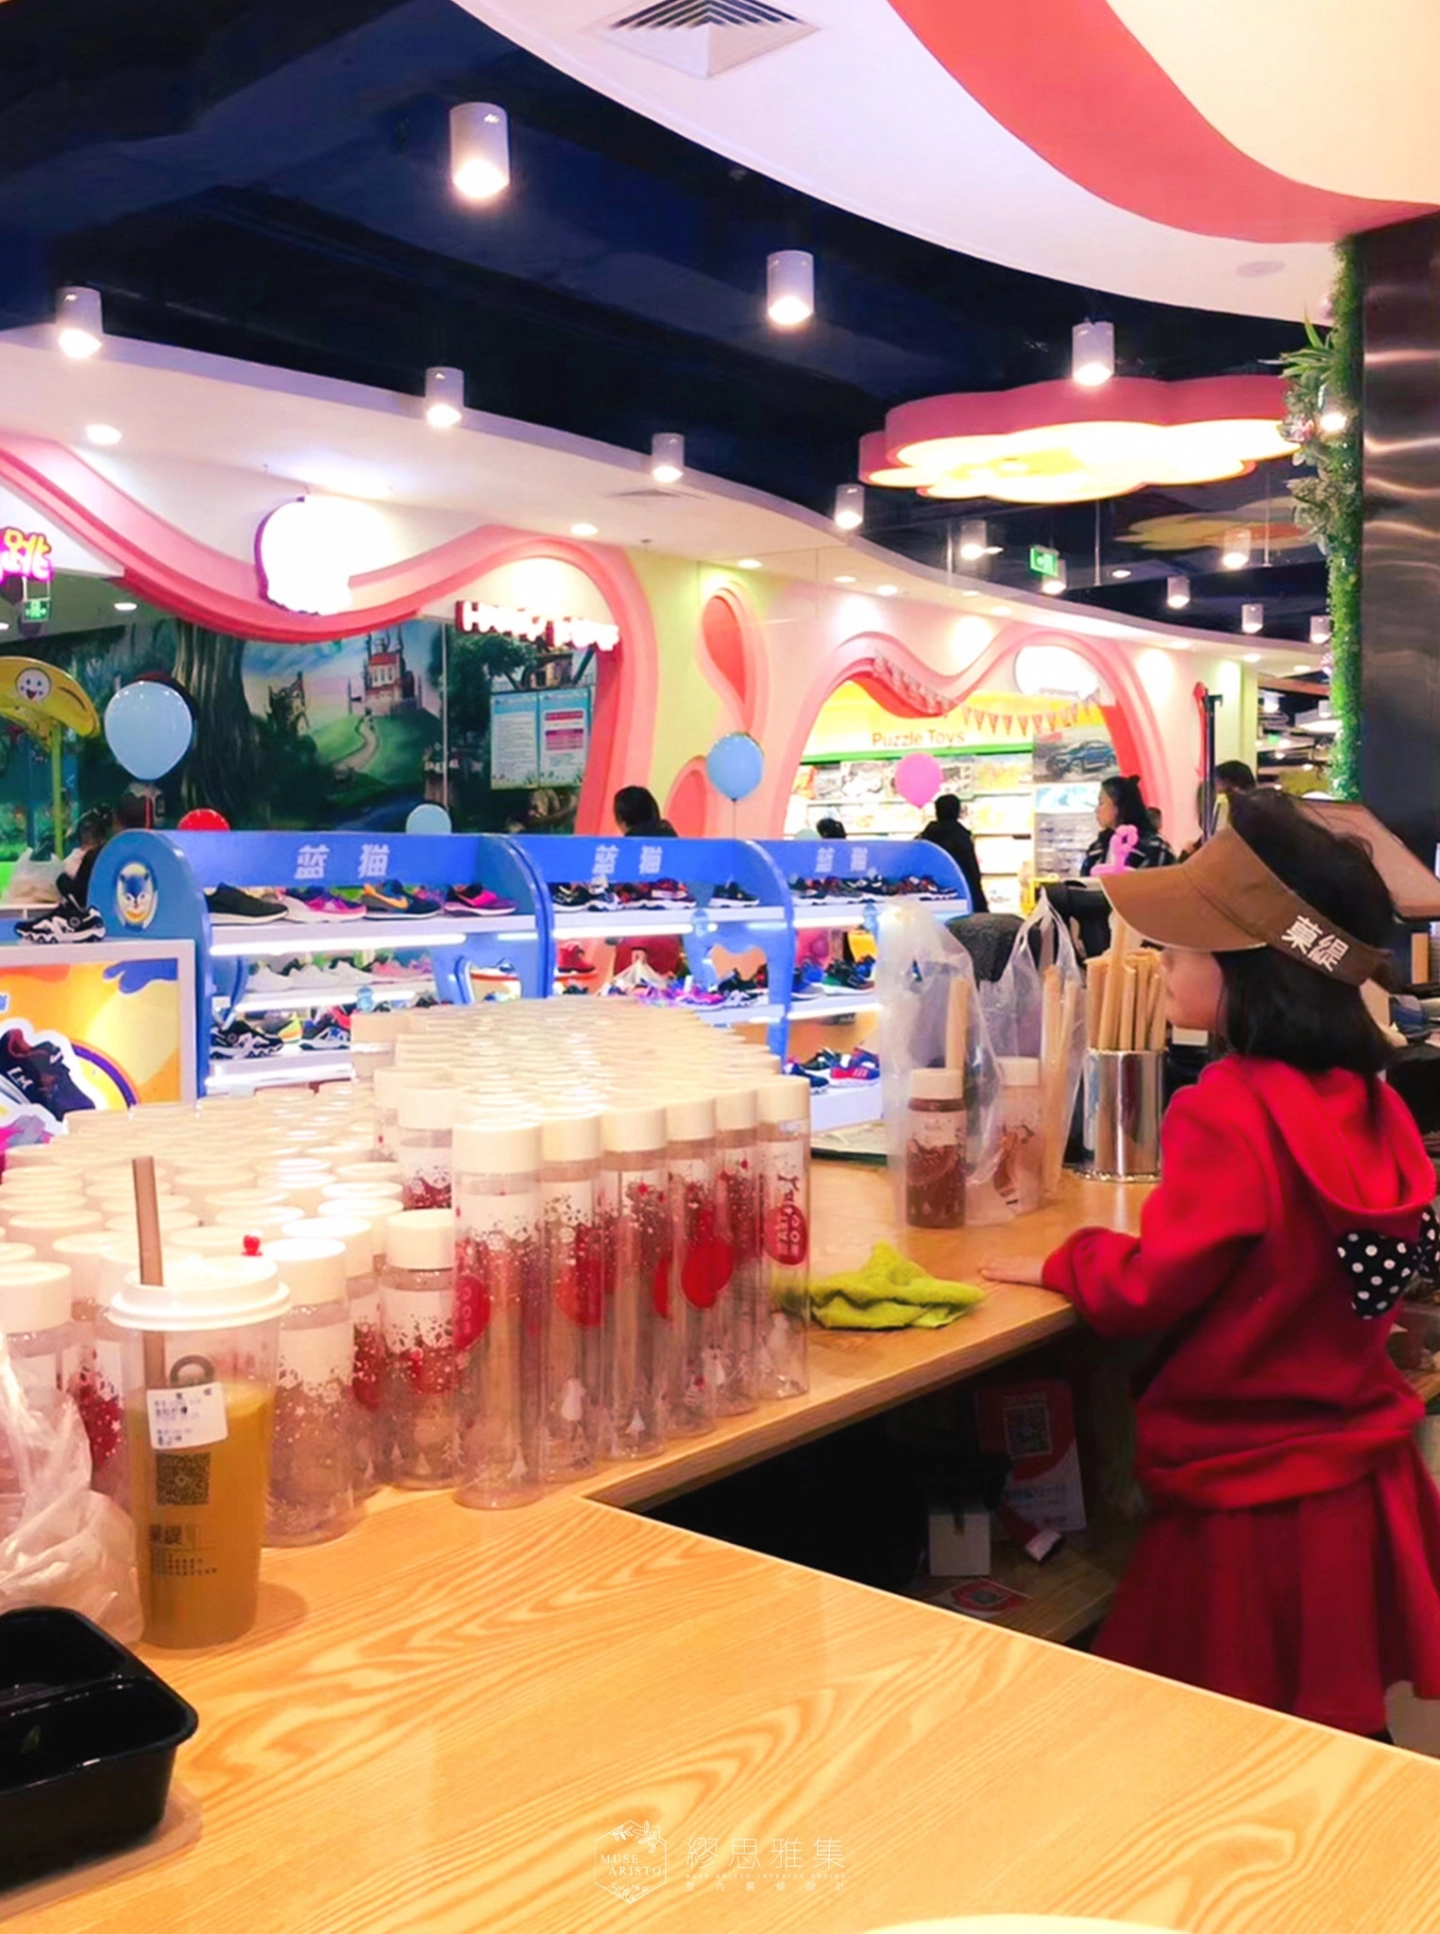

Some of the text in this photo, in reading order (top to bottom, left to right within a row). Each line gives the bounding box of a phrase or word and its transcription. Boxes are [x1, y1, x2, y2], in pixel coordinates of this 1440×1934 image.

[872, 729, 965, 749] Puzzle Toys
[294, 844, 390, 880] 蓝猫
[592, 844, 664, 875] 蓝猫
